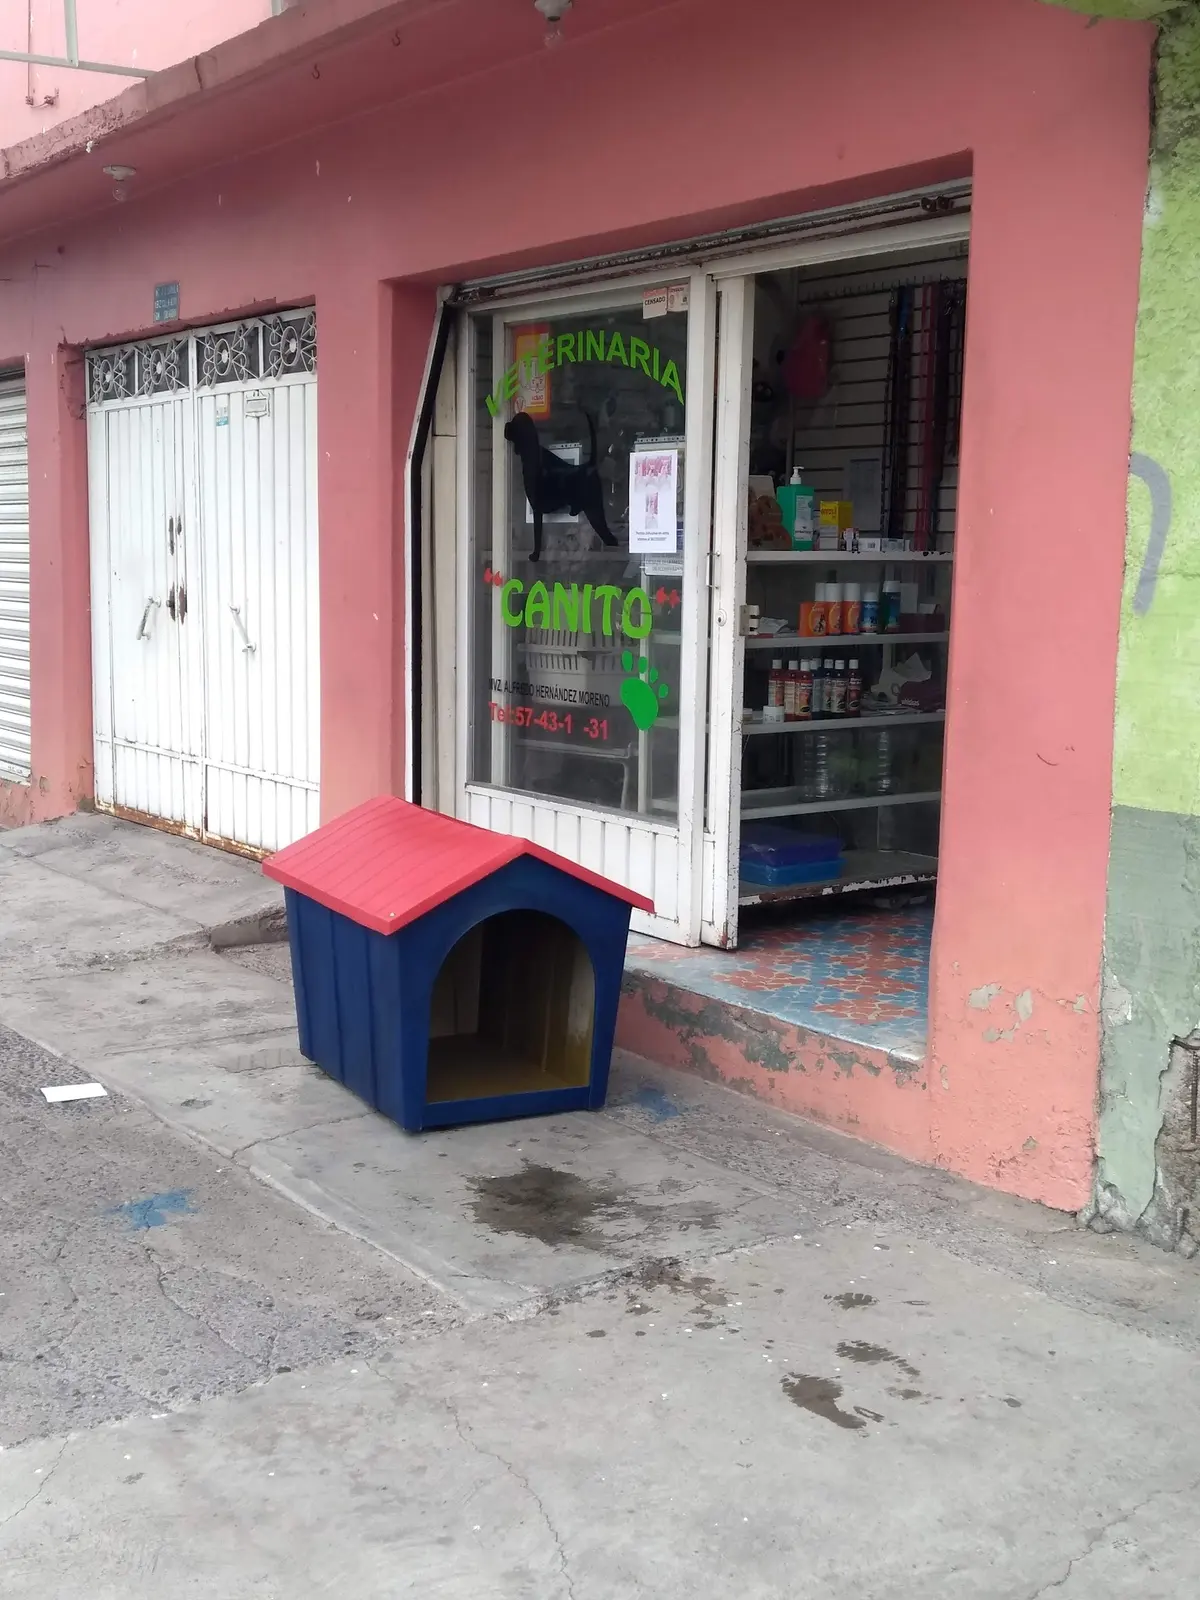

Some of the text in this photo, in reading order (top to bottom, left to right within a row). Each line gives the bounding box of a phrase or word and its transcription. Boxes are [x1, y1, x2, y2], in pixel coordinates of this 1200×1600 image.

[644, 296, 666, 306] CENSADO
[484, 329, 685, 418] VETERINARIA
[504, 680, 535, 697] ALFREDO
[535, 684, 578, 704] HERNÁNDEZ
[578, 690, 610, 708] MORENO
